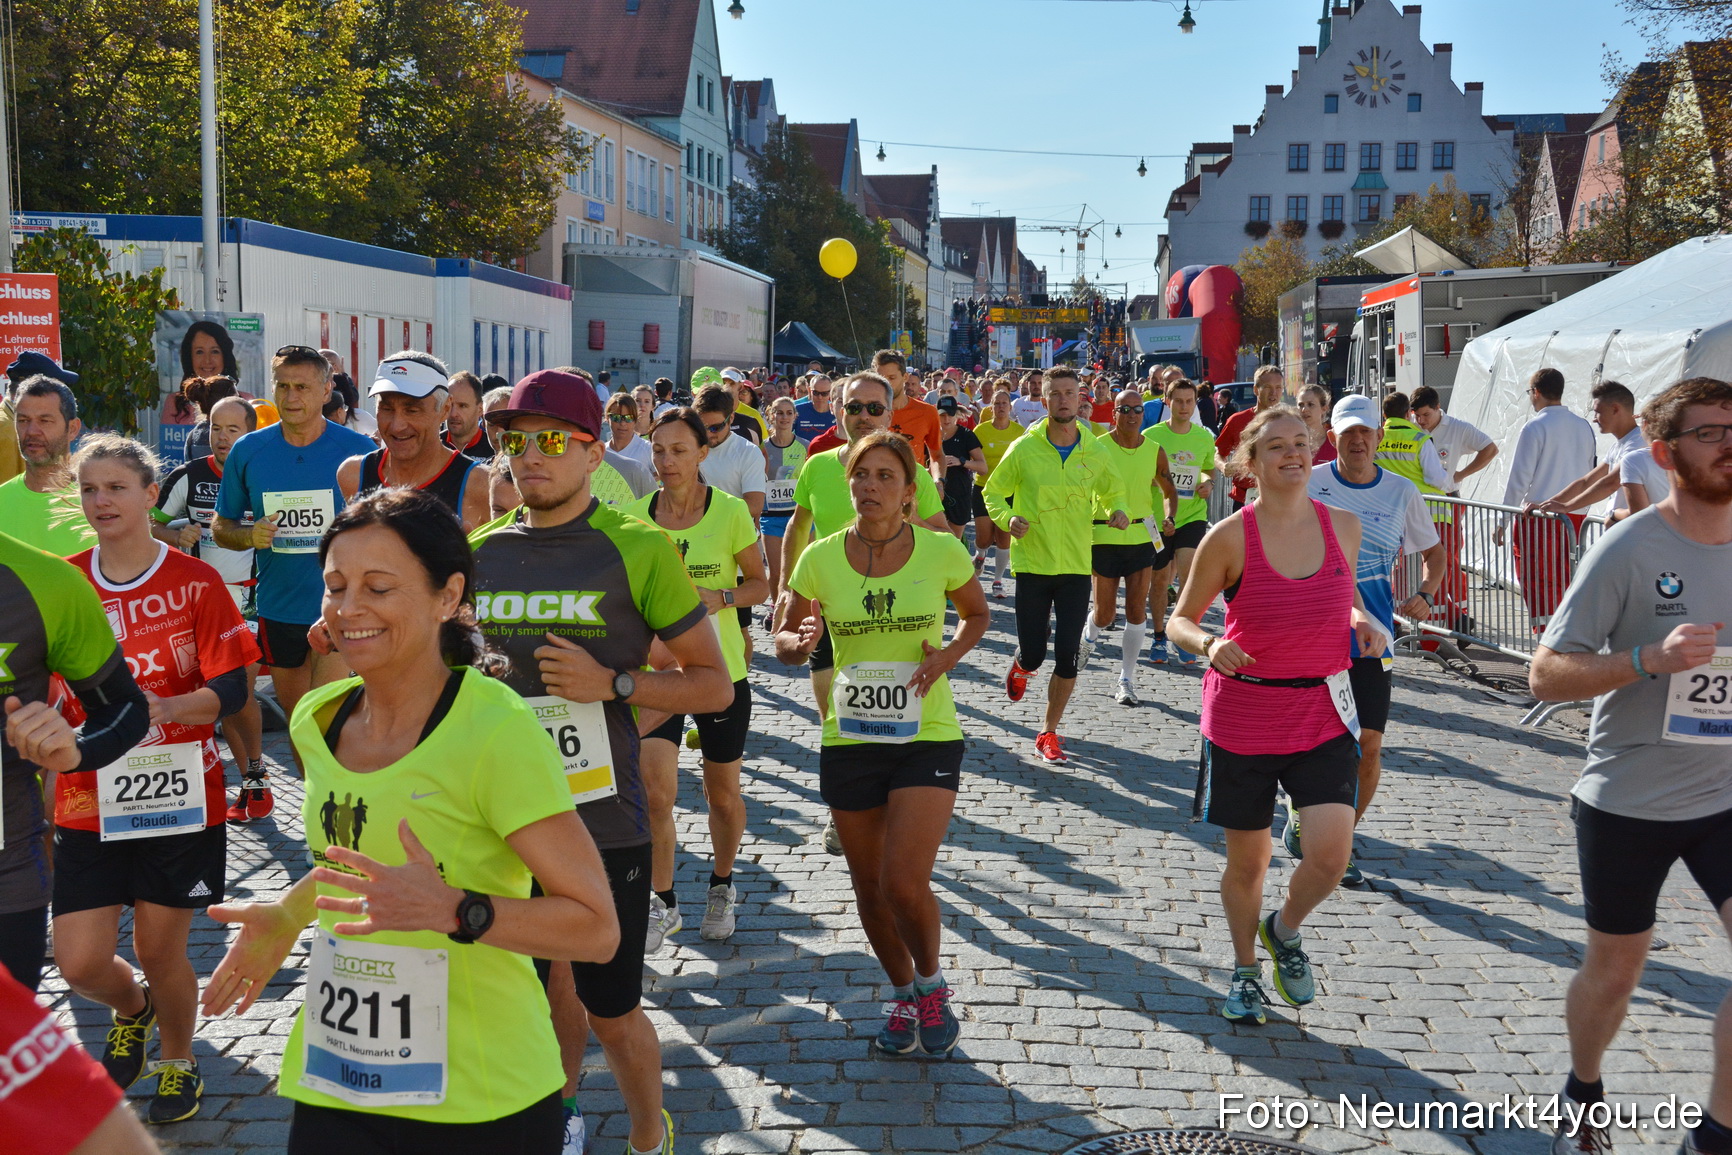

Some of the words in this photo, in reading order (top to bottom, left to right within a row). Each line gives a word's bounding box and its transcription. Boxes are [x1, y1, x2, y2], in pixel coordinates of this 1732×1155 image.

[1021, 311, 1056, 320] START
[4, 335, 35, 344] Lehrer
[37, 335, 50, 344] für
[773, 488, 794, 499] 3140
[276, 509, 324, 528] 2055
[286, 538, 317, 547] Michael
[475, 591, 608, 626] BOCK
[1655, 603, 1687, 611] PARTL
[134, 615, 188, 637] schenken
[501, 626, 514, 638] by
[517, 627, 550, 636] smart
[553, 627, 607, 639] concepts
[857, 669, 896, 678] BOCK
[1688, 674, 1732, 704] 23
[845, 685, 907, 710] 2300
[860, 722, 897, 735] Brigitte
[128, 753, 172, 767] BOCK
[114, 769, 189, 803] 2225
[123, 804, 145, 812] PARTL
[146, 801, 176, 810] Neumarkt
[131, 815, 178, 829] Claudia
[188, 888, 212, 897] adidas
[333, 952, 396, 978] BOCK
[320, 980, 411, 1040] 2211
[327, 1035, 349, 1051] PARTL
[350, 1044, 395, 1058] Neumarkt
[341, 1063, 382, 1088] Ilona
